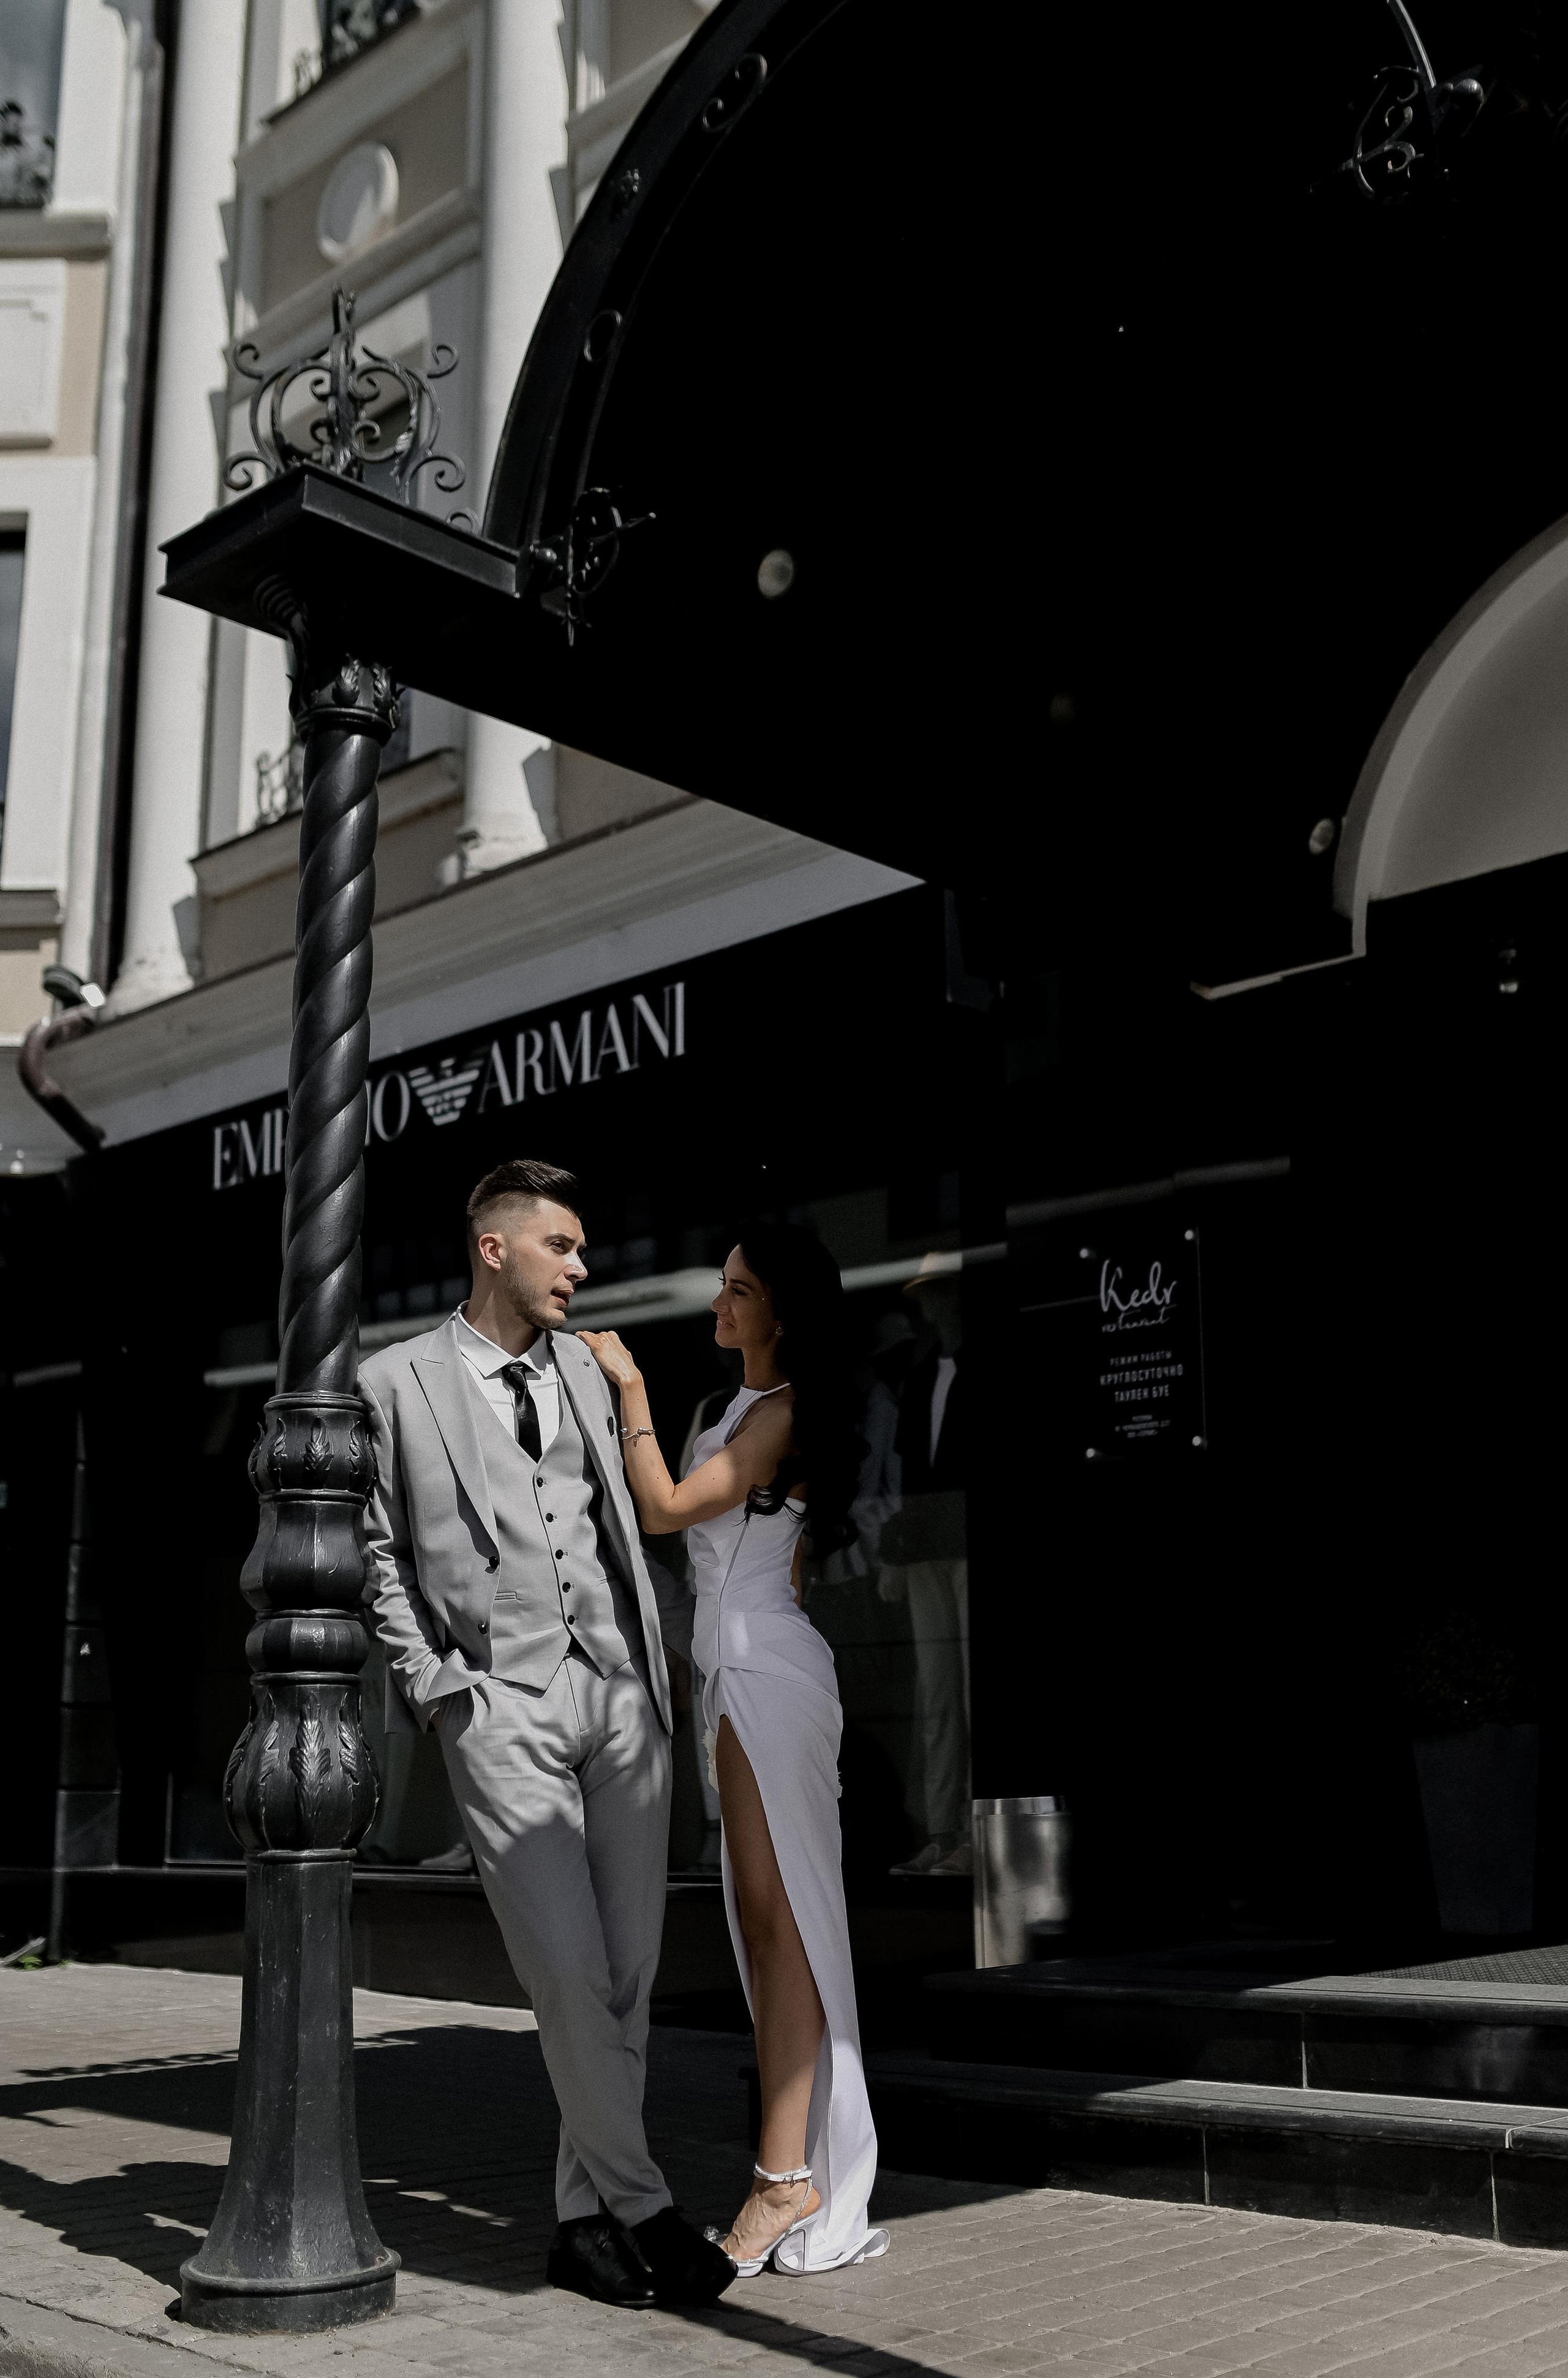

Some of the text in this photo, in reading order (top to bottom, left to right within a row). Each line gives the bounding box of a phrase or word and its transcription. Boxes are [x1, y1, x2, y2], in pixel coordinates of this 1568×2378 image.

[212, 981, 686, 1191] EMPIO ARMANI
[1099, 1364, 1183, 1386] КРУГЛОСУТОЧНО
